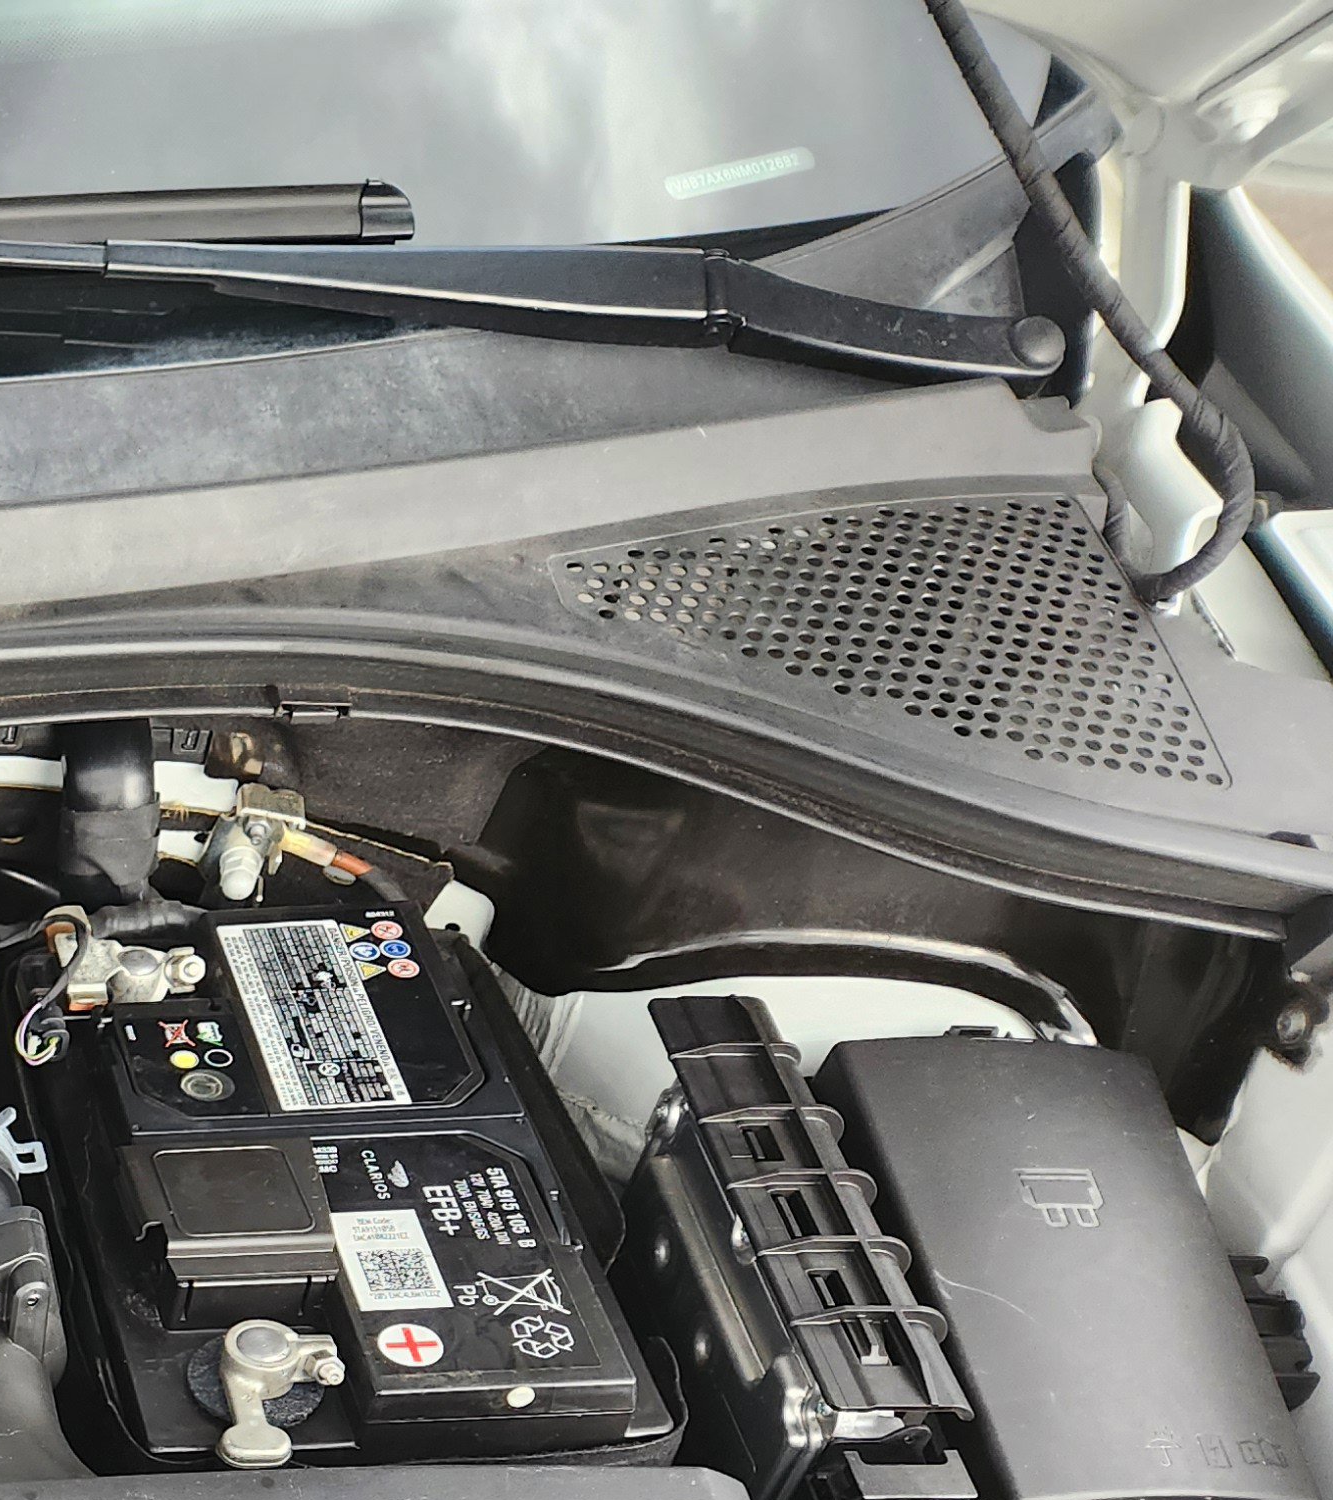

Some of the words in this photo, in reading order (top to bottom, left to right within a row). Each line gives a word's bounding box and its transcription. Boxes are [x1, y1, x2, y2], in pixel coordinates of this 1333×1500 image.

[360, 1150, 391, 1200] CLARIOS
[486, 1167, 510, 1189] 5TA
[422, 1184, 463, 1237] EFB+
[495, 1189, 520, 1212] 915
[506, 1212, 531, 1235] 105
[517, 1239, 537, 1249] B
[453, 1283, 477, 1306] Pb
